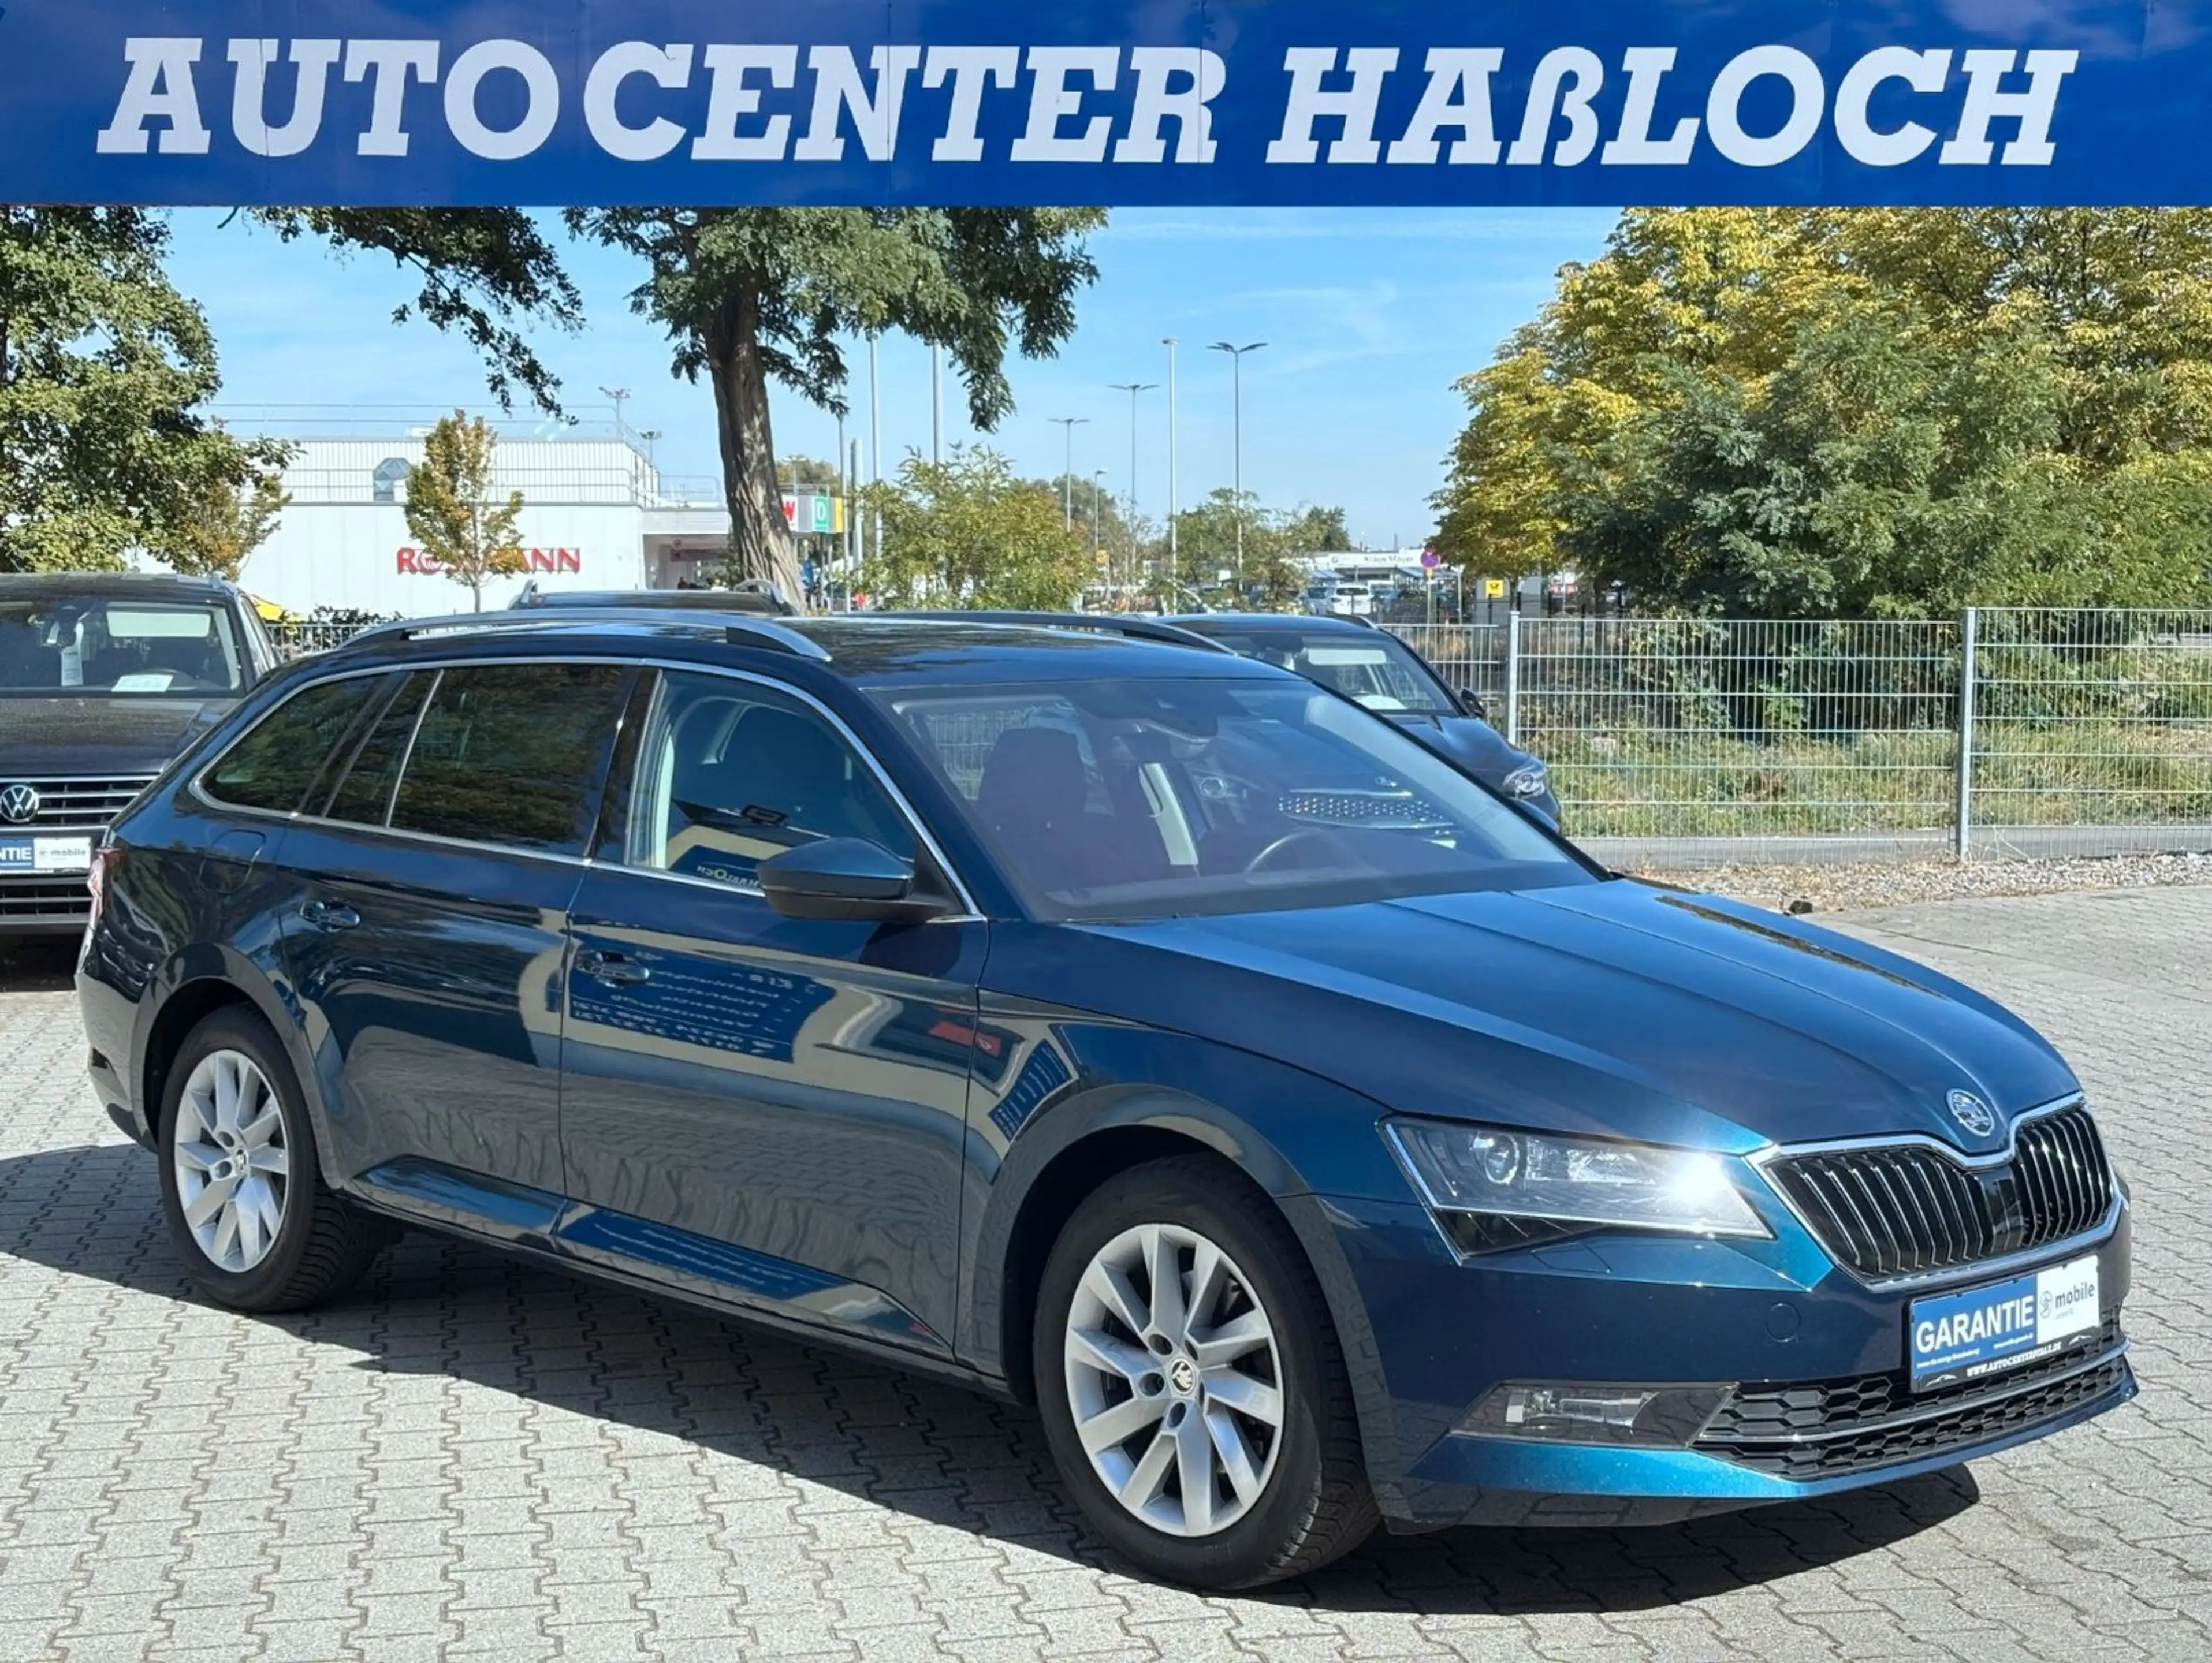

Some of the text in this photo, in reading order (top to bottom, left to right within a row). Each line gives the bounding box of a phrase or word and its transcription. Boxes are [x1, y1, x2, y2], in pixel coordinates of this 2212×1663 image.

[98, 38, 2078, 166] AUTOCENTER HAßLOCH
[396, 546, 580, 575] ROANN
[2054, 1282, 2095, 1310] mobile
[1916, 1295, 2034, 1353] GARANTIE
